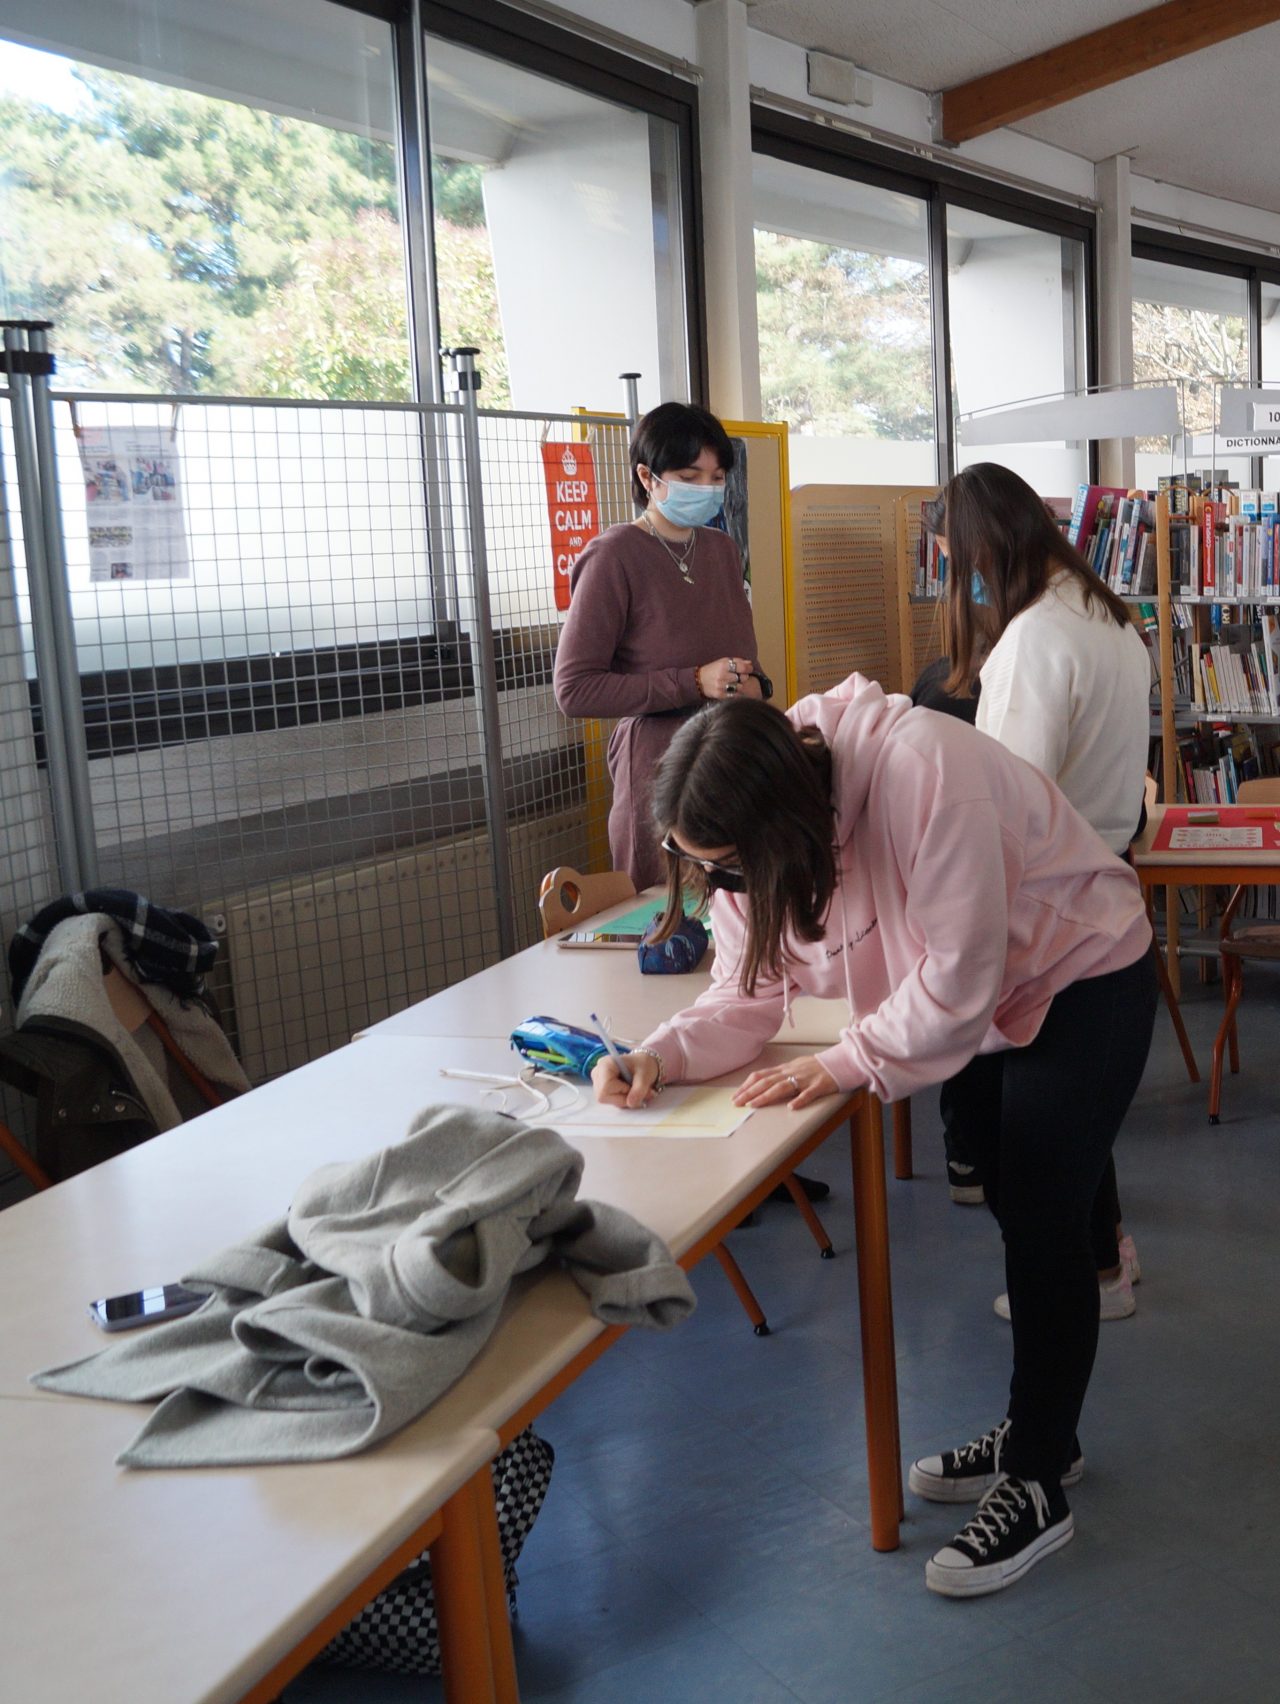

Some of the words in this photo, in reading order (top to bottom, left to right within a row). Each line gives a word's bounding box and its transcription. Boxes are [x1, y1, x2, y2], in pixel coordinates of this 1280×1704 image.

[556, 480, 588, 503] KEEP
[555, 509, 592, 532] CALM
[569, 535, 583, 547] AND
